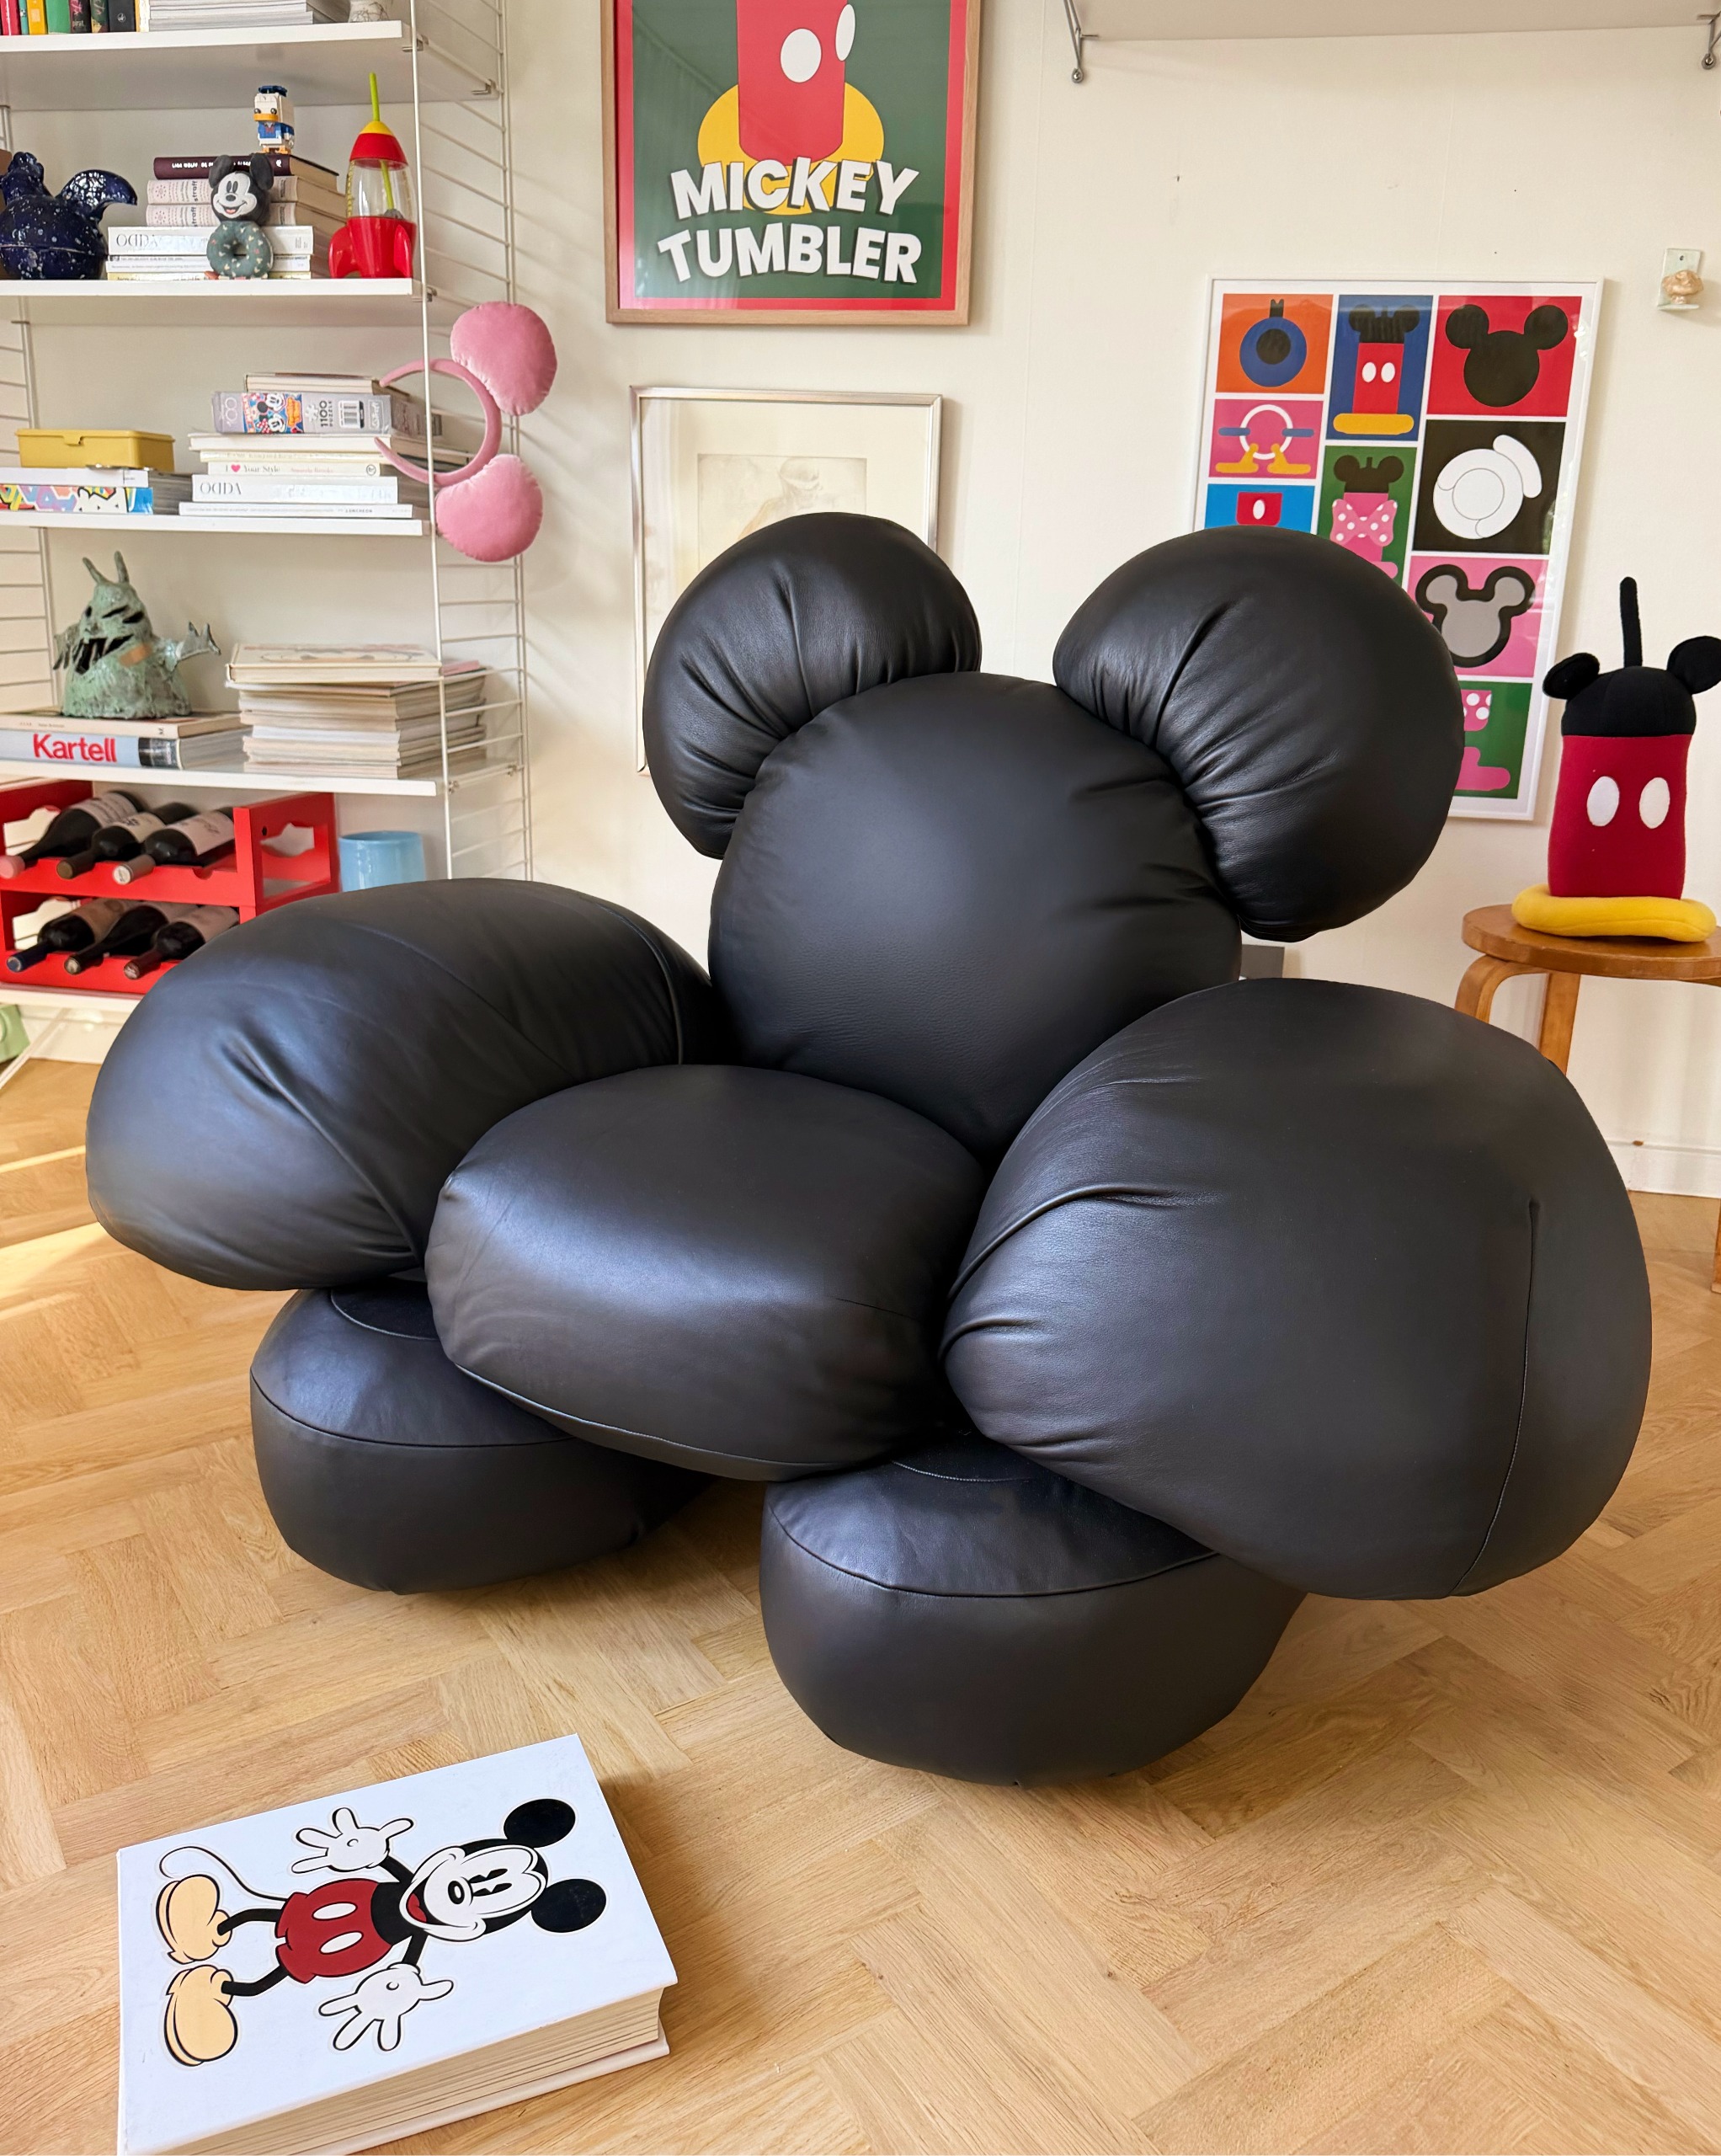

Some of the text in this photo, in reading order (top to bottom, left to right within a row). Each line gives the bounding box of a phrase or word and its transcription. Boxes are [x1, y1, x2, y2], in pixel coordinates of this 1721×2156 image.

[671, 157, 919, 220] MICKEY
[657, 222, 922, 284] TUMBLER
[319, 400, 328, 428] 1100
[33, 734, 118, 763] Kartell
